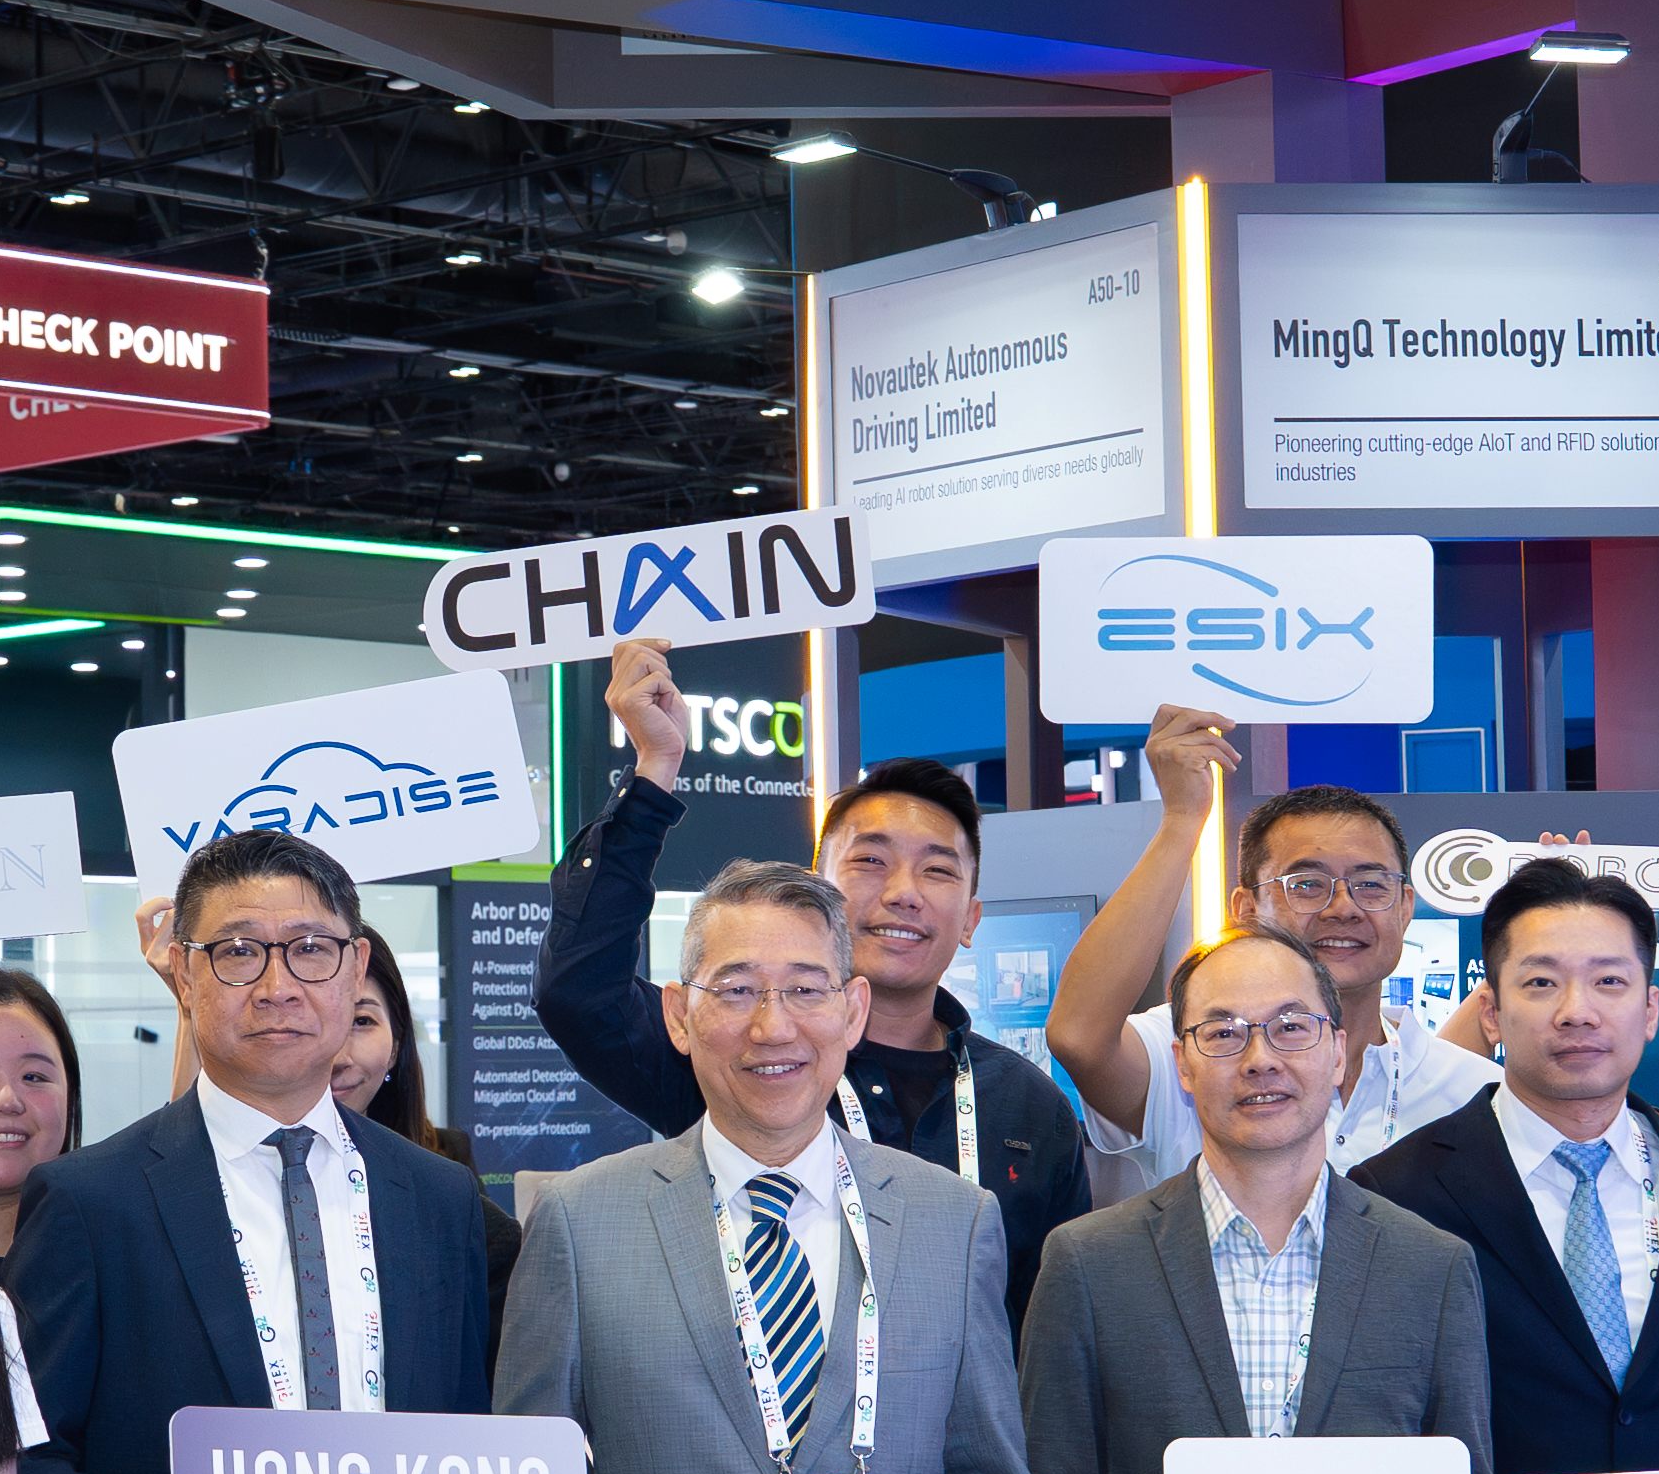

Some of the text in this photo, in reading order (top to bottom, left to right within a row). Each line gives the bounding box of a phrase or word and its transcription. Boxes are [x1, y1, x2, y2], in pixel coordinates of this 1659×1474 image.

[1089, 270, 1139, 305] A50-10
[109, 321, 228, 372] POINT
[1274, 320, 1373, 369] MingQ
[1383, 320, 1565, 368] Technology
[852, 334, 1067, 403] Novautek Autonomous
[853, 392, 995, 454] Driving Limited
[1275, 435, 1363, 459] Pioneering
[1368, 434, 1473, 459] cutting-edge
[1521, 434, 1551, 453] and
[1558, 434, 1595, 453] RFID
[896, 488, 905, 505] AI
[909, 485, 934, 503] robot
[939, 478, 977, 498] solution
[982, 470, 1018, 491] serving
[1023, 465, 1060, 483] diverse
[1065, 455, 1097, 475] needs
[1101, 446, 1143, 474] globally
[1277, 464, 1355, 482] industries
[441, 516, 857, 653] CHAIN
[695, 774, 712, 793] of
[715, 775, 740, 795] the
[472, 902, 516, 921] Arbor
[472, 927, 501, 945] and
[472, 961, 533, 976] AI-Powered
[473, 981, 527, 996] Protection
[473, 1003, 513, 1020] Against
[473, 1036, 535, 1051] Global DDoS
[474, 1069, 579, 1084] Automated Detection
[474, 1089, 576, 1107] Mitigation Cloud and
[474, 1122, 590, 1141] On-premises Protection
